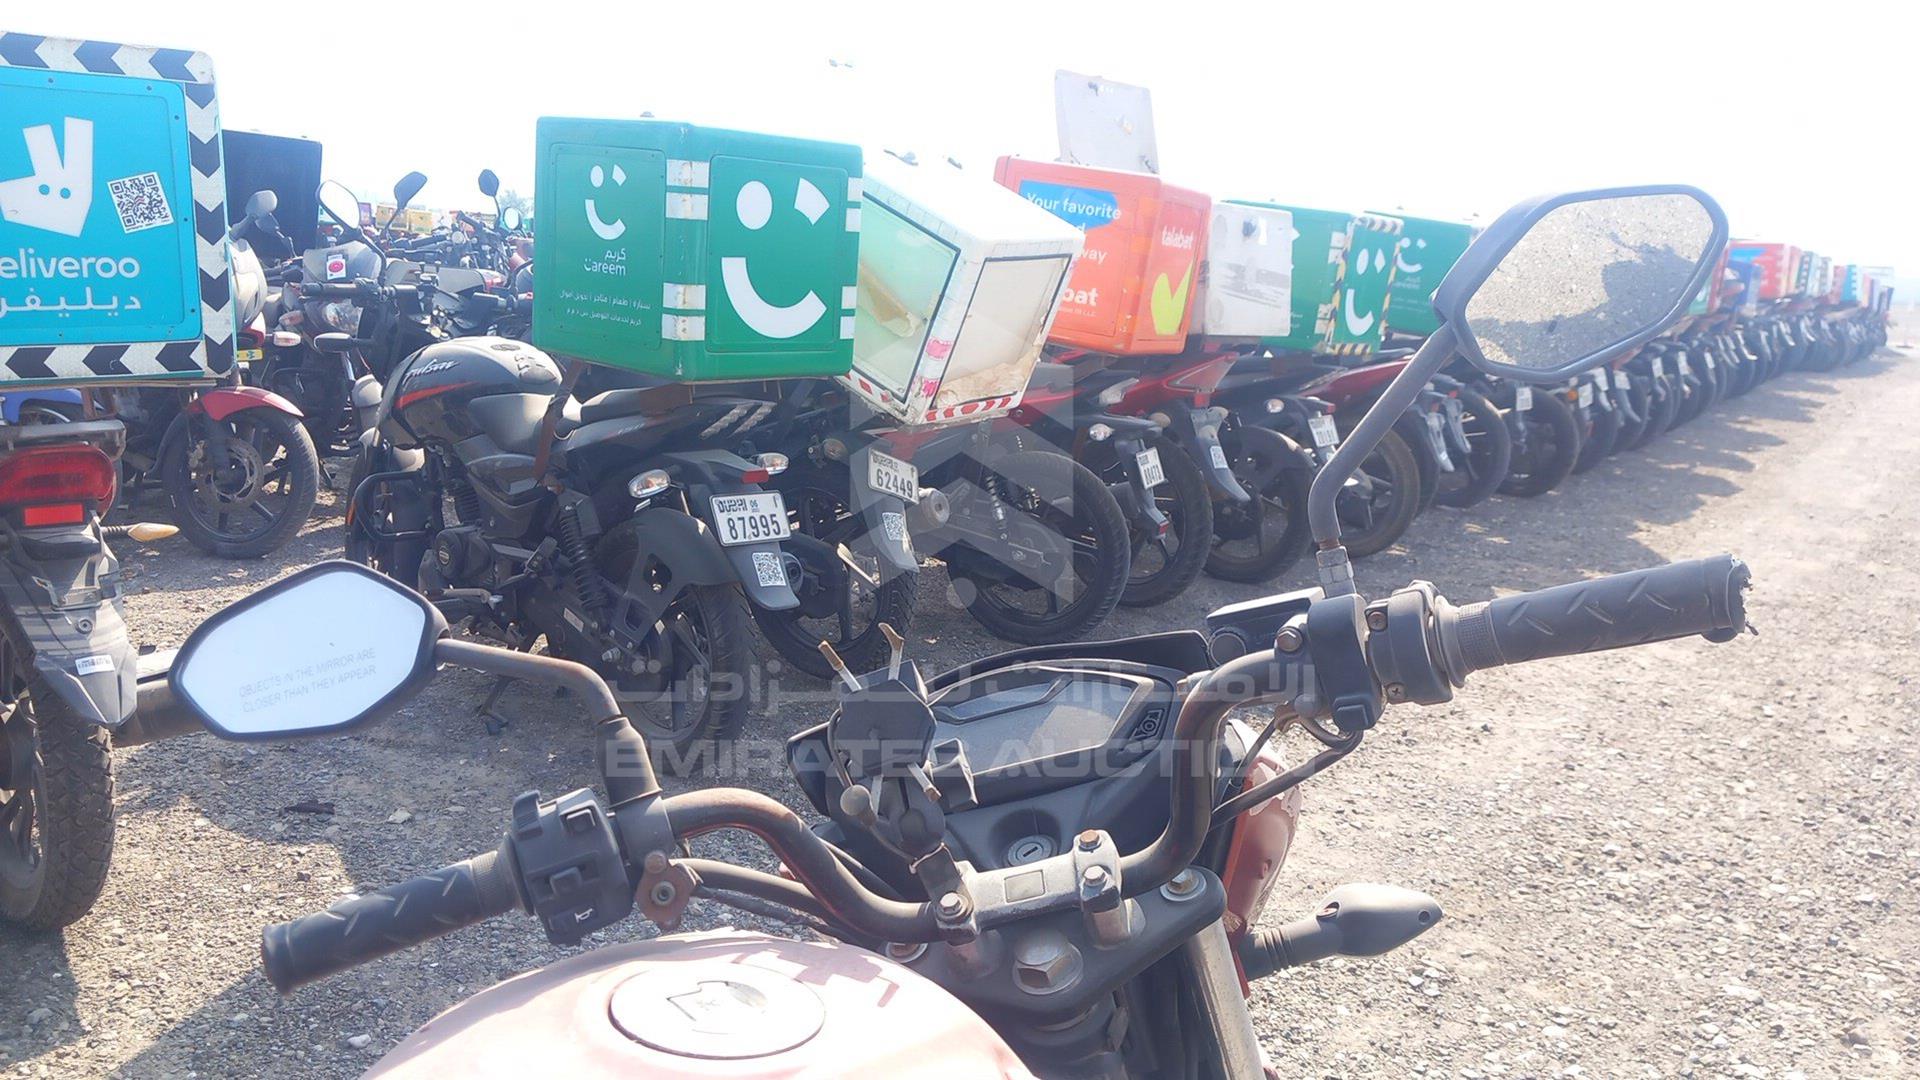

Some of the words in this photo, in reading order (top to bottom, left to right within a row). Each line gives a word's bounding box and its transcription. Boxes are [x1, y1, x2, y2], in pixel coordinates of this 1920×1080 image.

[1027, 192, 1059, 210] Your
[1063, 197, 1122, 220] favorite
[0, 247, 140, 279] eliveroo
[1079, 248, 1107, 265] way
[0, 286, 141, 318] ديليفر
[876, 468, 913, 498] 62449
[727, 513, 781, 540] 87995
[239, 675, 282, 698] OBJECTS
[284, 671, 294, 683] IN
[296, 664, 314, 681] THE
[316, 654, 354, 674] MIRROR
[356, 647, 376, 664] ARE
[242, 692, 281, 713] CLOSER
[284, 684, 309, 701] THAN
[311, 675, 335, 692] THEY
[337, 664, 377, 685] APPEAR
